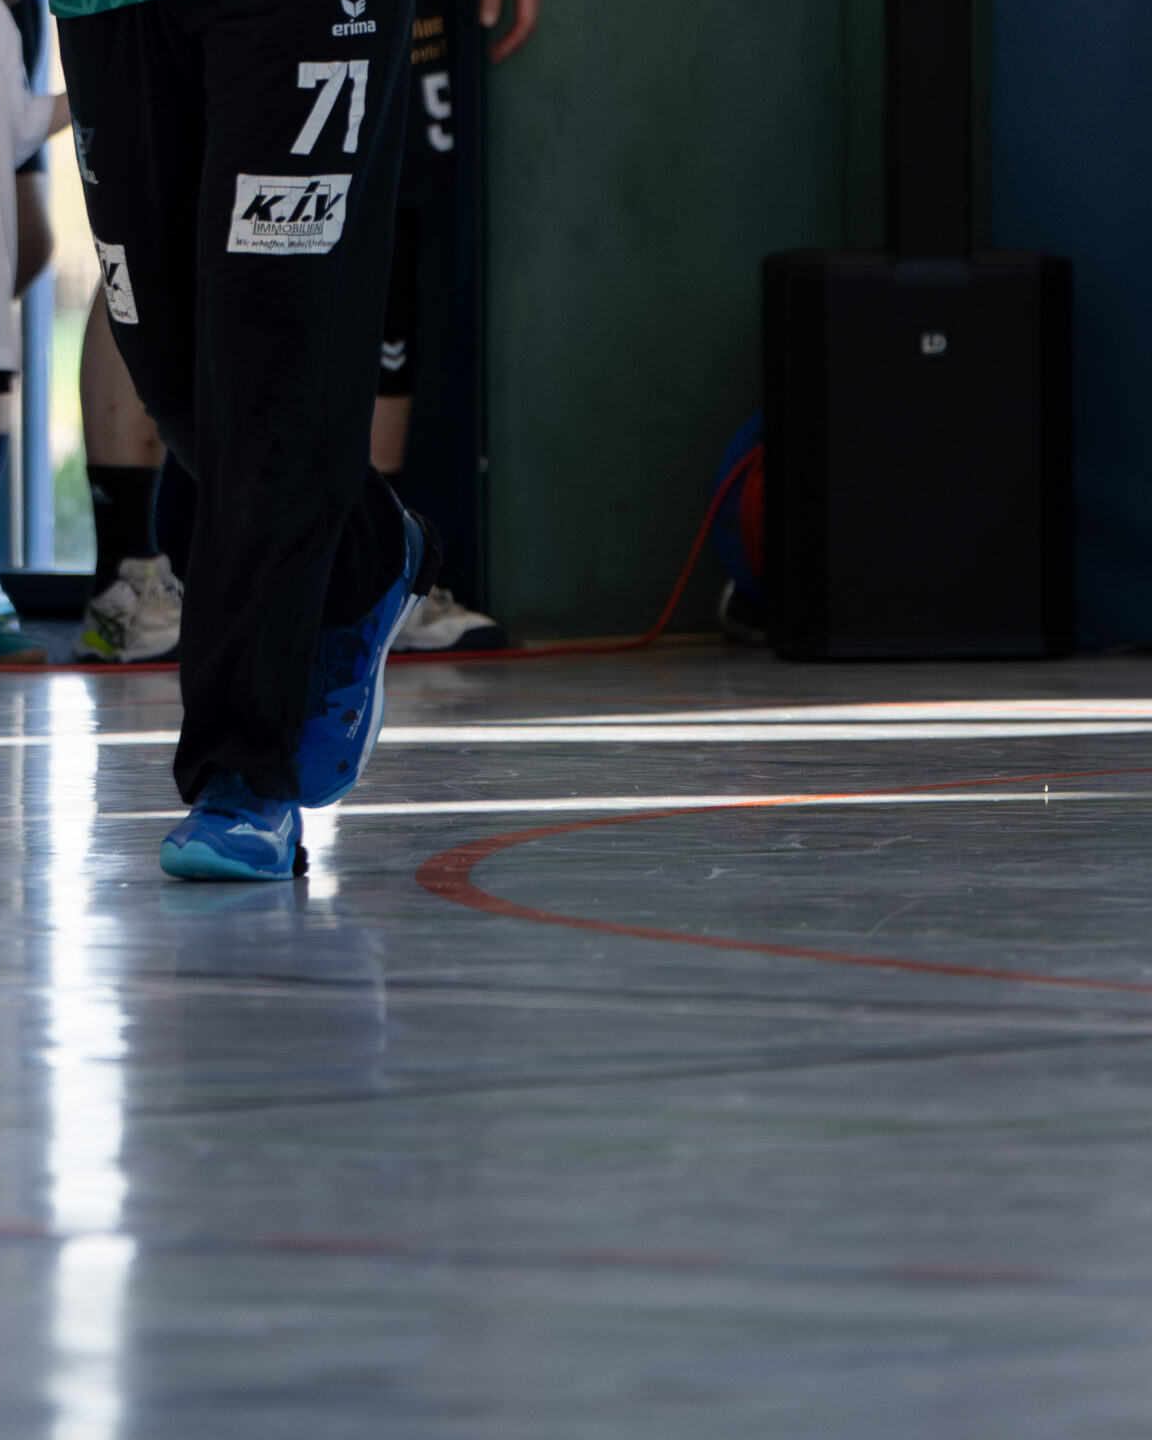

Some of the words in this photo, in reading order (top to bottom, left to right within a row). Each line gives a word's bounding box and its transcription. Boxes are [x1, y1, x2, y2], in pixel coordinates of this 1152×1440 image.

[332, 19, 377, 37] erima
[290, 59, 370, 156] 71
[256, 223, 323, 235] IMMOBILIEN
